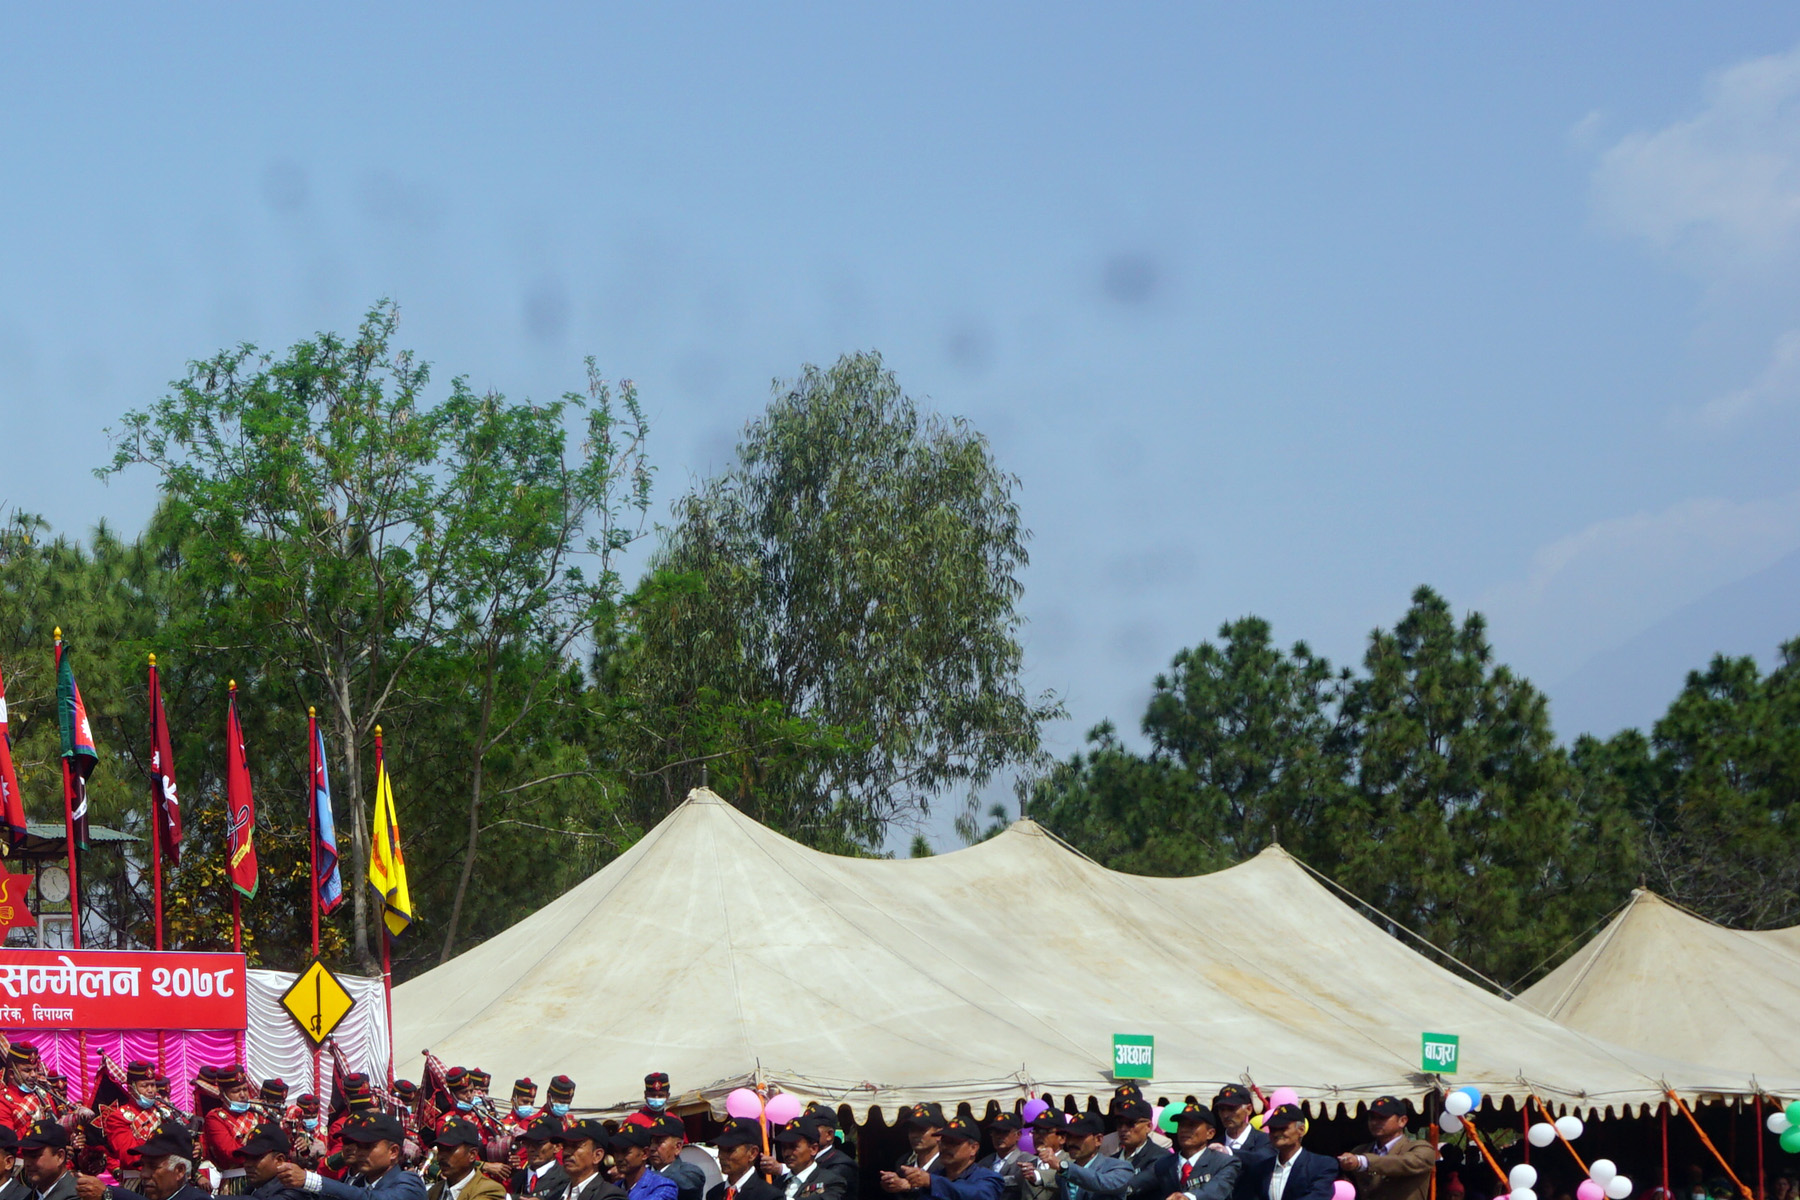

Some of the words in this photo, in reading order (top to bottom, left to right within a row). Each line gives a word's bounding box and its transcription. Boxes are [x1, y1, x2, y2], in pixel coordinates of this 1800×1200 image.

[151, 967, 235, 998] २०७८
[32, 1003, 74, 1021] दिपायल
[1114, 1044, 1153, 1066] अछाम
[1424, 1041, 1457, 1066] बाजुरा
